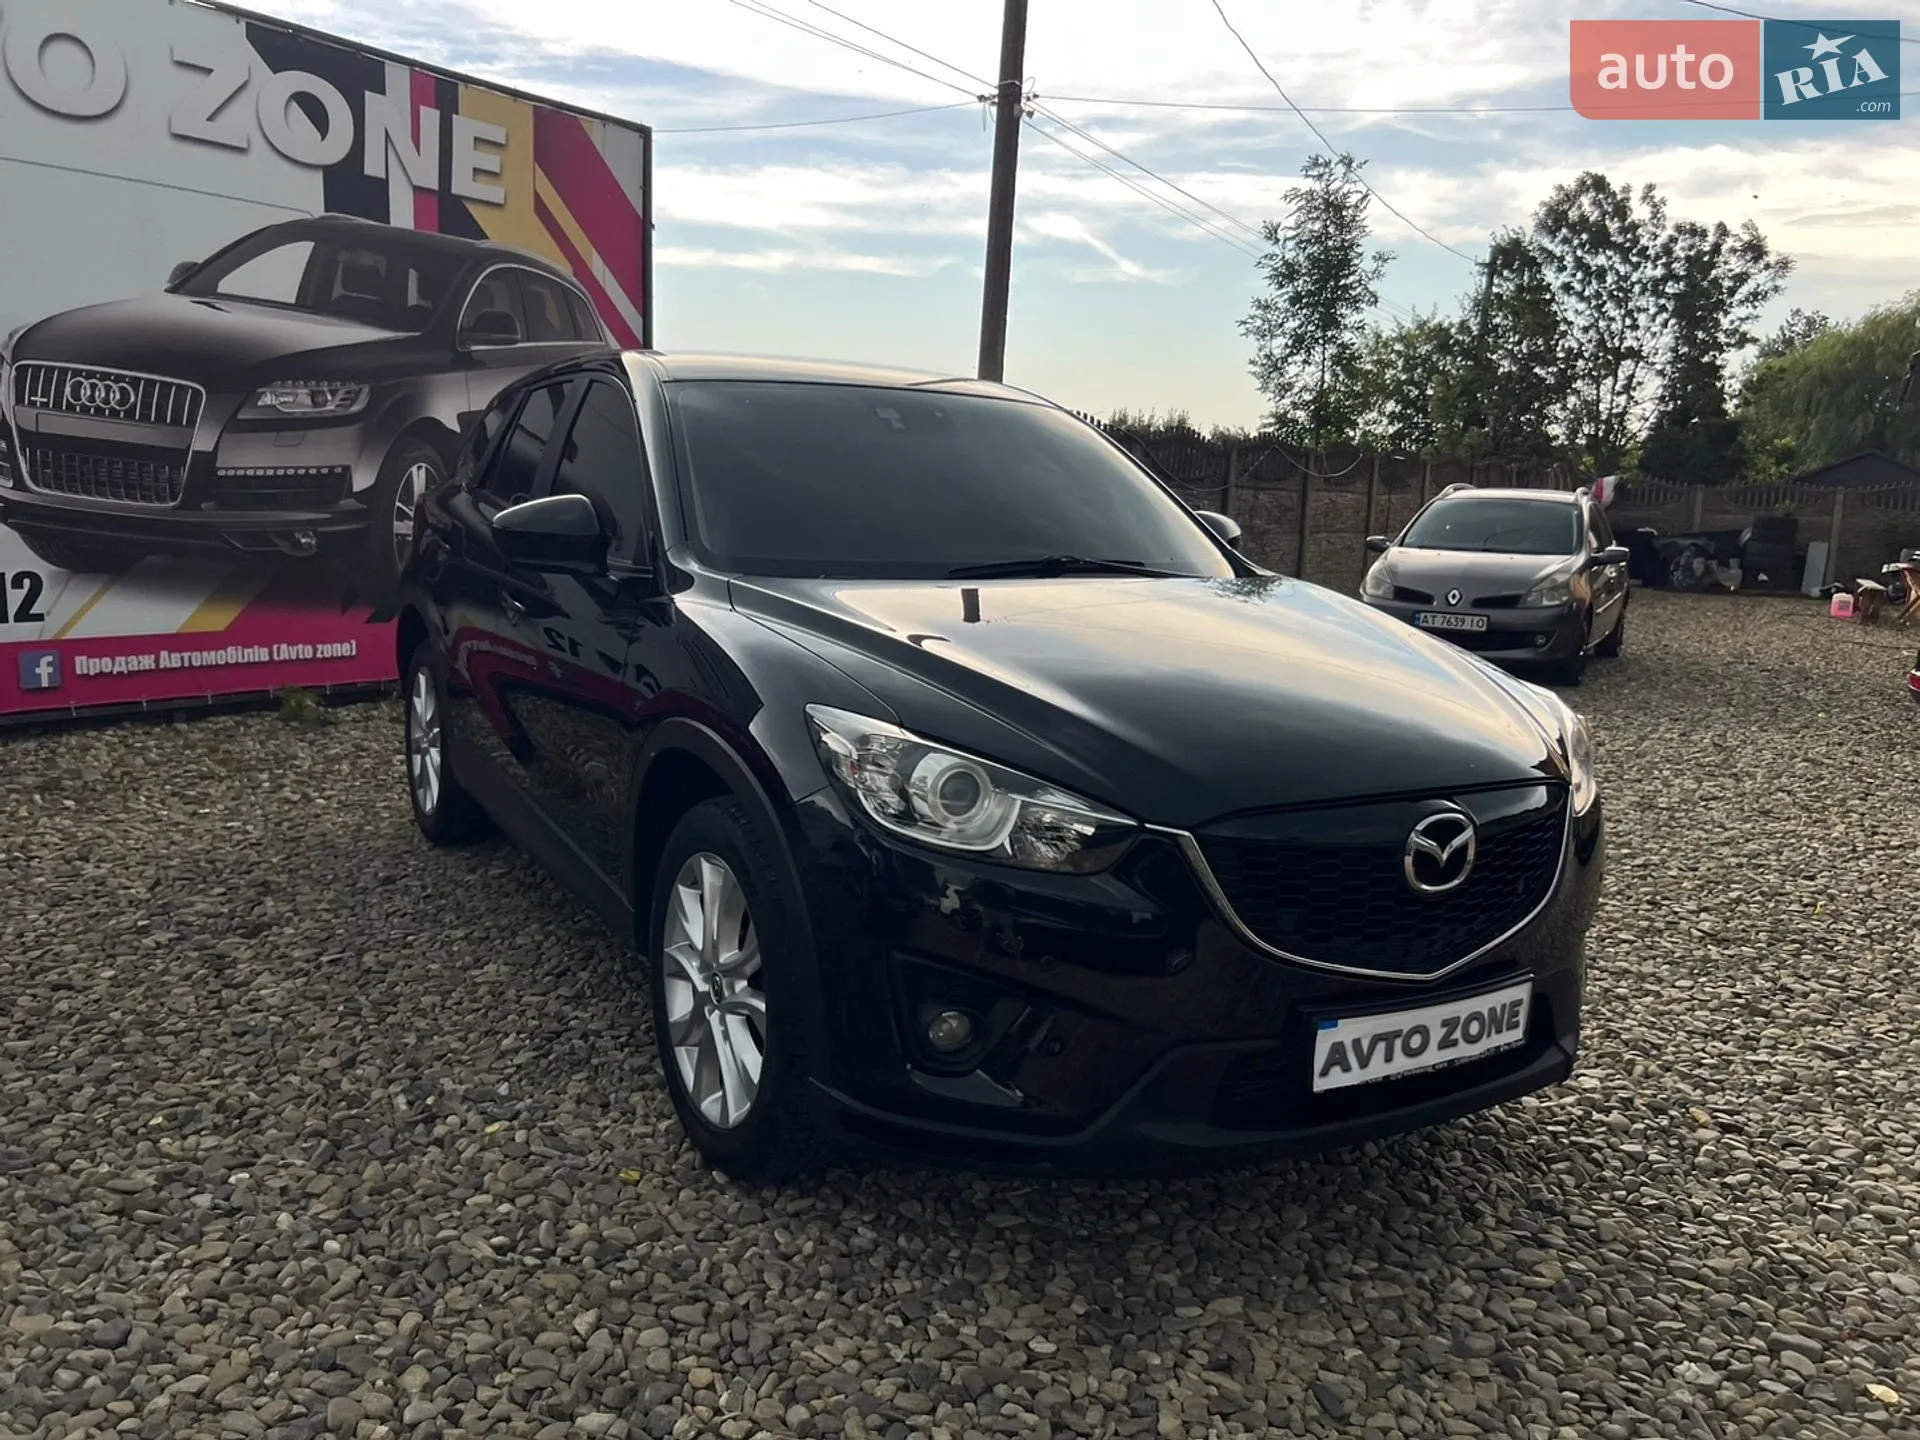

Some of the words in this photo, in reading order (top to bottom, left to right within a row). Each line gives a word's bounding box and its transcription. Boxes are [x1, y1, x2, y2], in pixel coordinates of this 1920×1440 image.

[169, 44, 507, 204] ZONE
[75, 654, 155, 676] Продаж
[159, 646, 270, 669] Автомобілів
[272, 643, 313, 662] (Avto
[316, 640, 357, 659] zone)
[1319, 1024, 1431, 1078] AVTO
[1437, 998, 1524, 1051] ZONE
